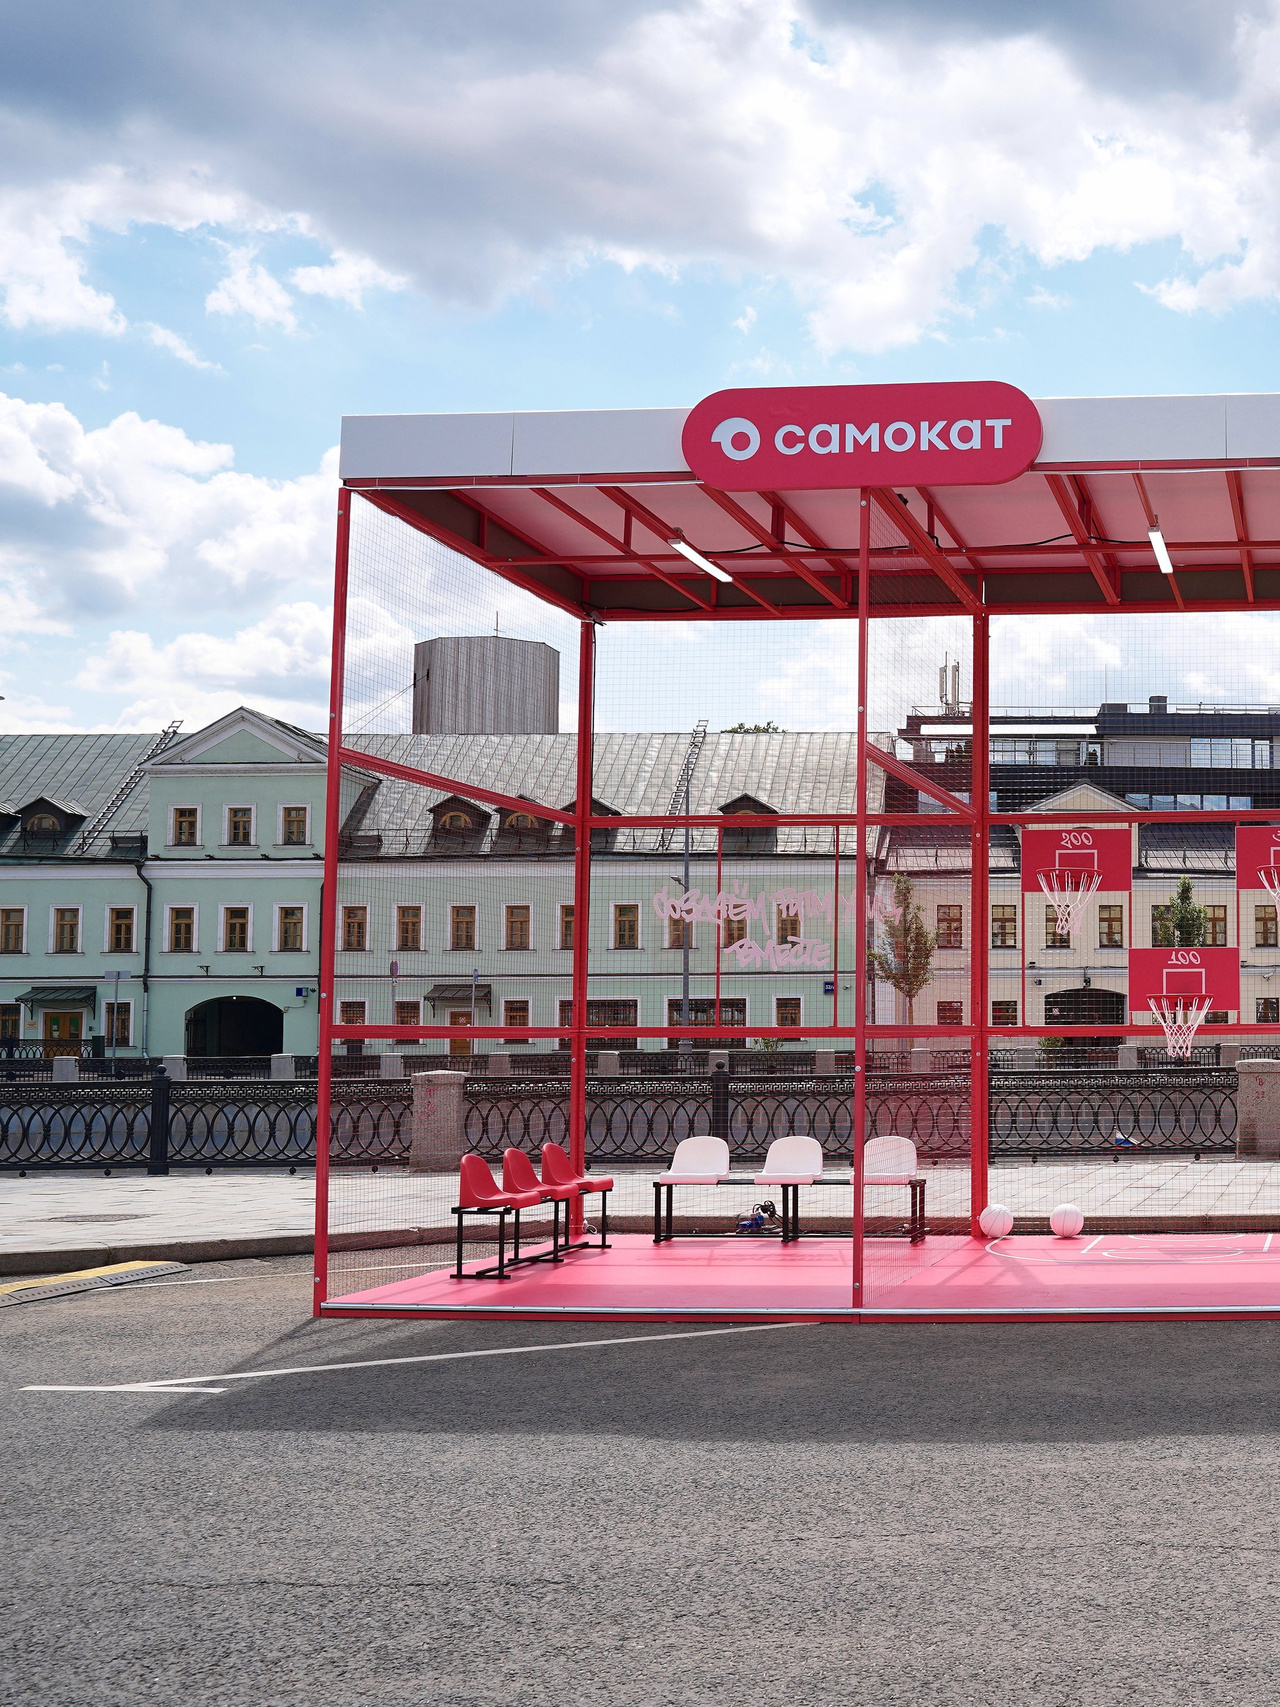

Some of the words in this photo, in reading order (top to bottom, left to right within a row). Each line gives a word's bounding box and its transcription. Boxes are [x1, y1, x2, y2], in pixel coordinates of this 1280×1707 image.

[774, 418, 1012, 456] самокат
[1061, 832, 1094, 848] 200
[724, 936, 830, 971] ВМЕСТЕ
[1168, 950, 1201, 965] 100
